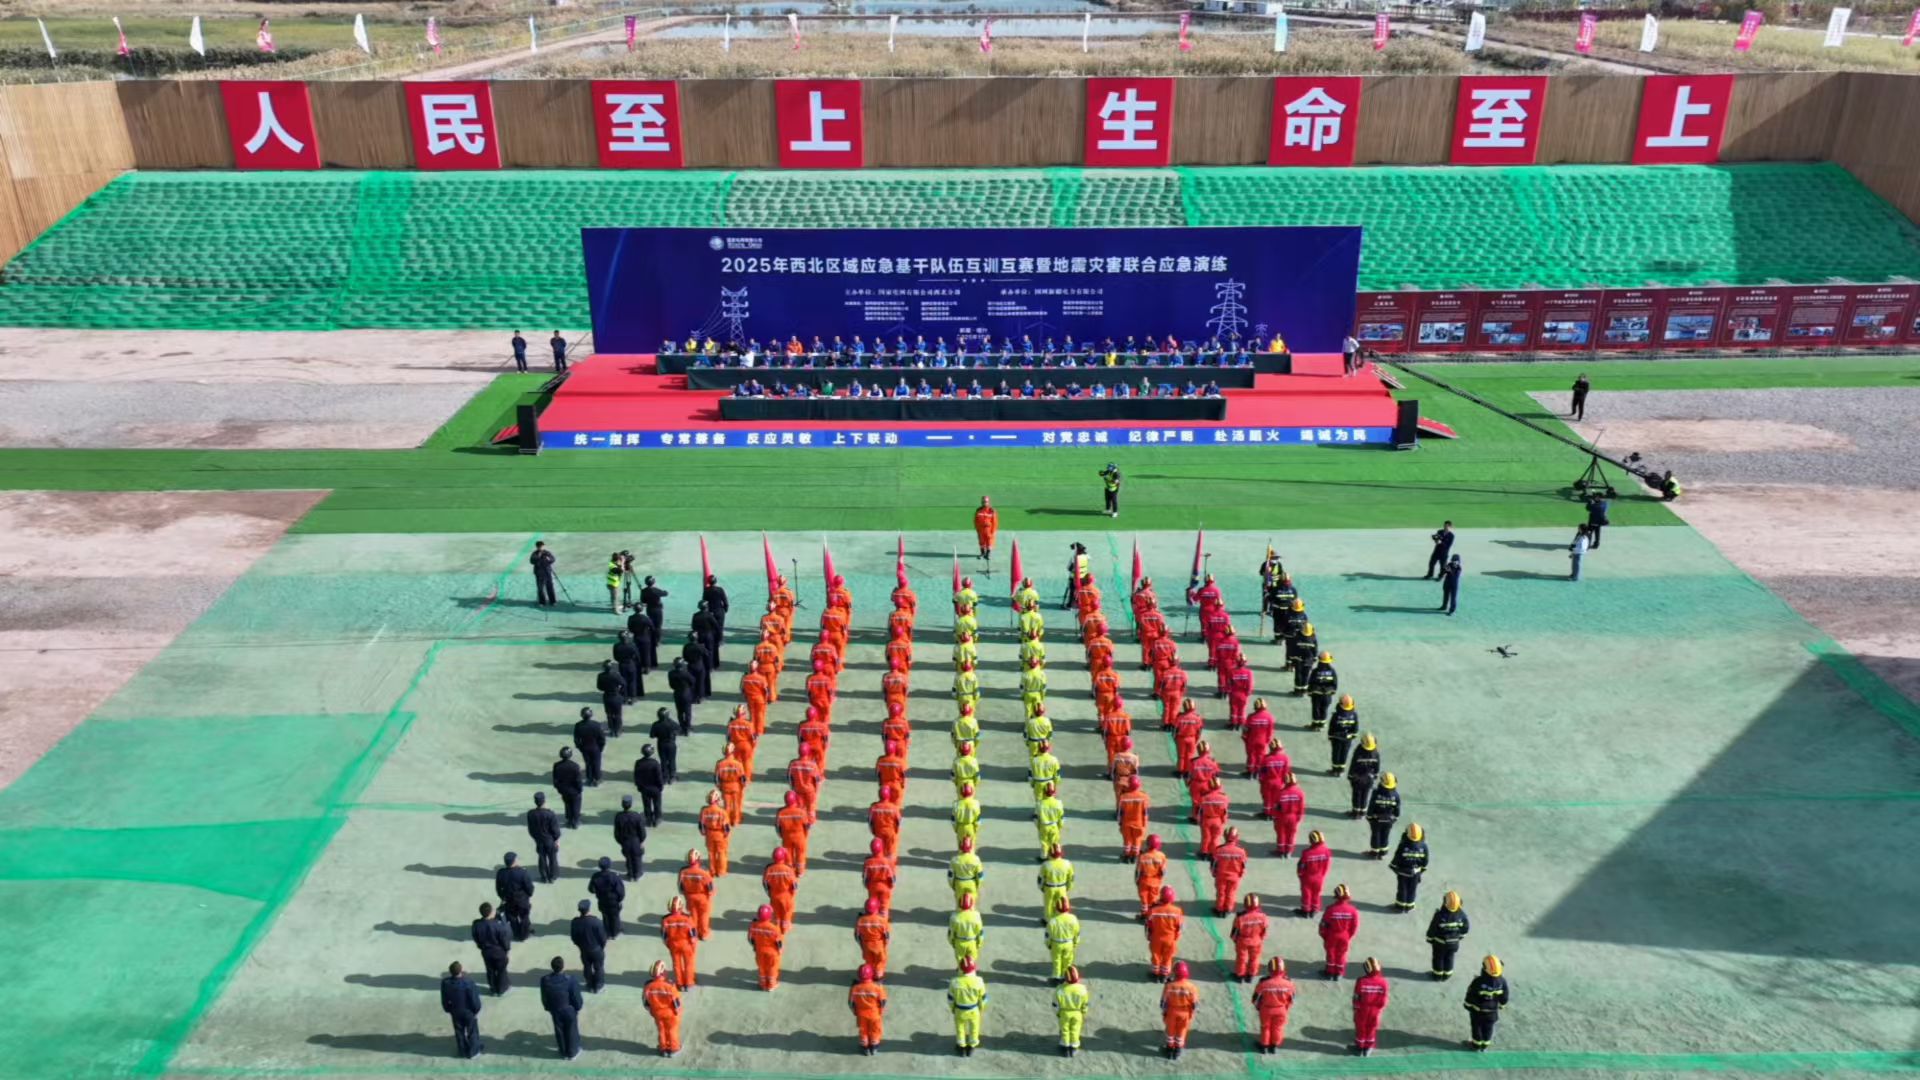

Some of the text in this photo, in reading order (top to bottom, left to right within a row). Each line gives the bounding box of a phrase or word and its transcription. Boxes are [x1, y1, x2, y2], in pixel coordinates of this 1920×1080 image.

[244, 91, 852, 154] 人民至上
[1097, 86, 1712, 151] 生命至上
[720, 256, 1228, 274] 2025年西北区域应急基干队伍互训互赛暨地震灾害联合应急演练
[574, 433, 640, 445] 统一指挥
[660, 433, 726, 445] 专常兼备
[746, 433, 812, 445] 反应灵敏
[832, 433, 898, 445] 上下联动
[1042, 431, 1108, 443] 对党忠诚
[1129, 430, 1193, 442] 纪律严明
